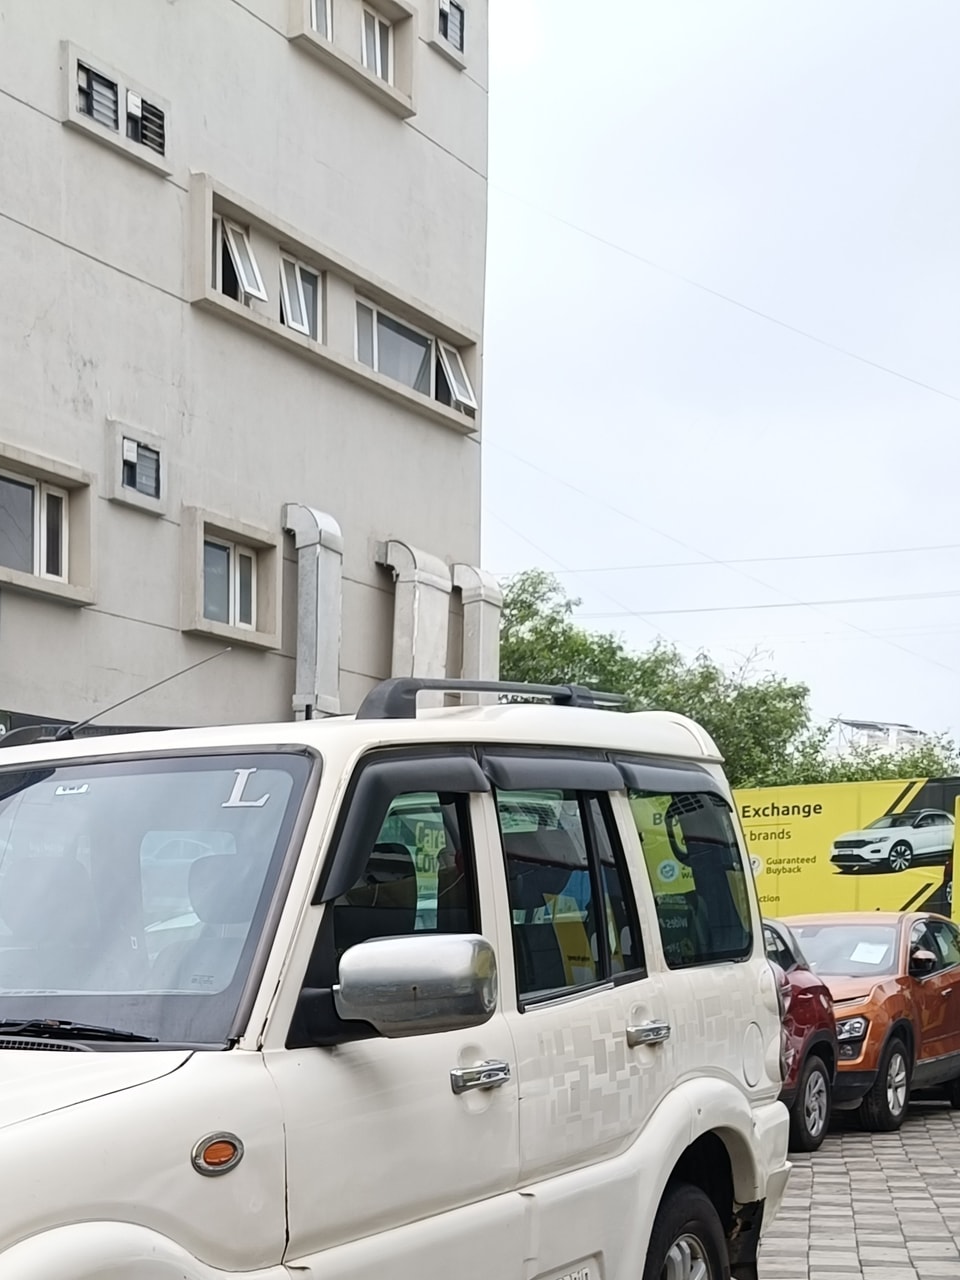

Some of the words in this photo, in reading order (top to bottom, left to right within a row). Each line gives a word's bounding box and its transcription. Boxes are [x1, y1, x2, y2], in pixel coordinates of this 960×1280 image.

[221, 768, 270, 807] L
[742, 802, 822, 818] Exchange
[750, 828, 791, 841] brands
[766, 856, 816, 865] Guaranteed
[766, 866, 801, 875] Buyback
